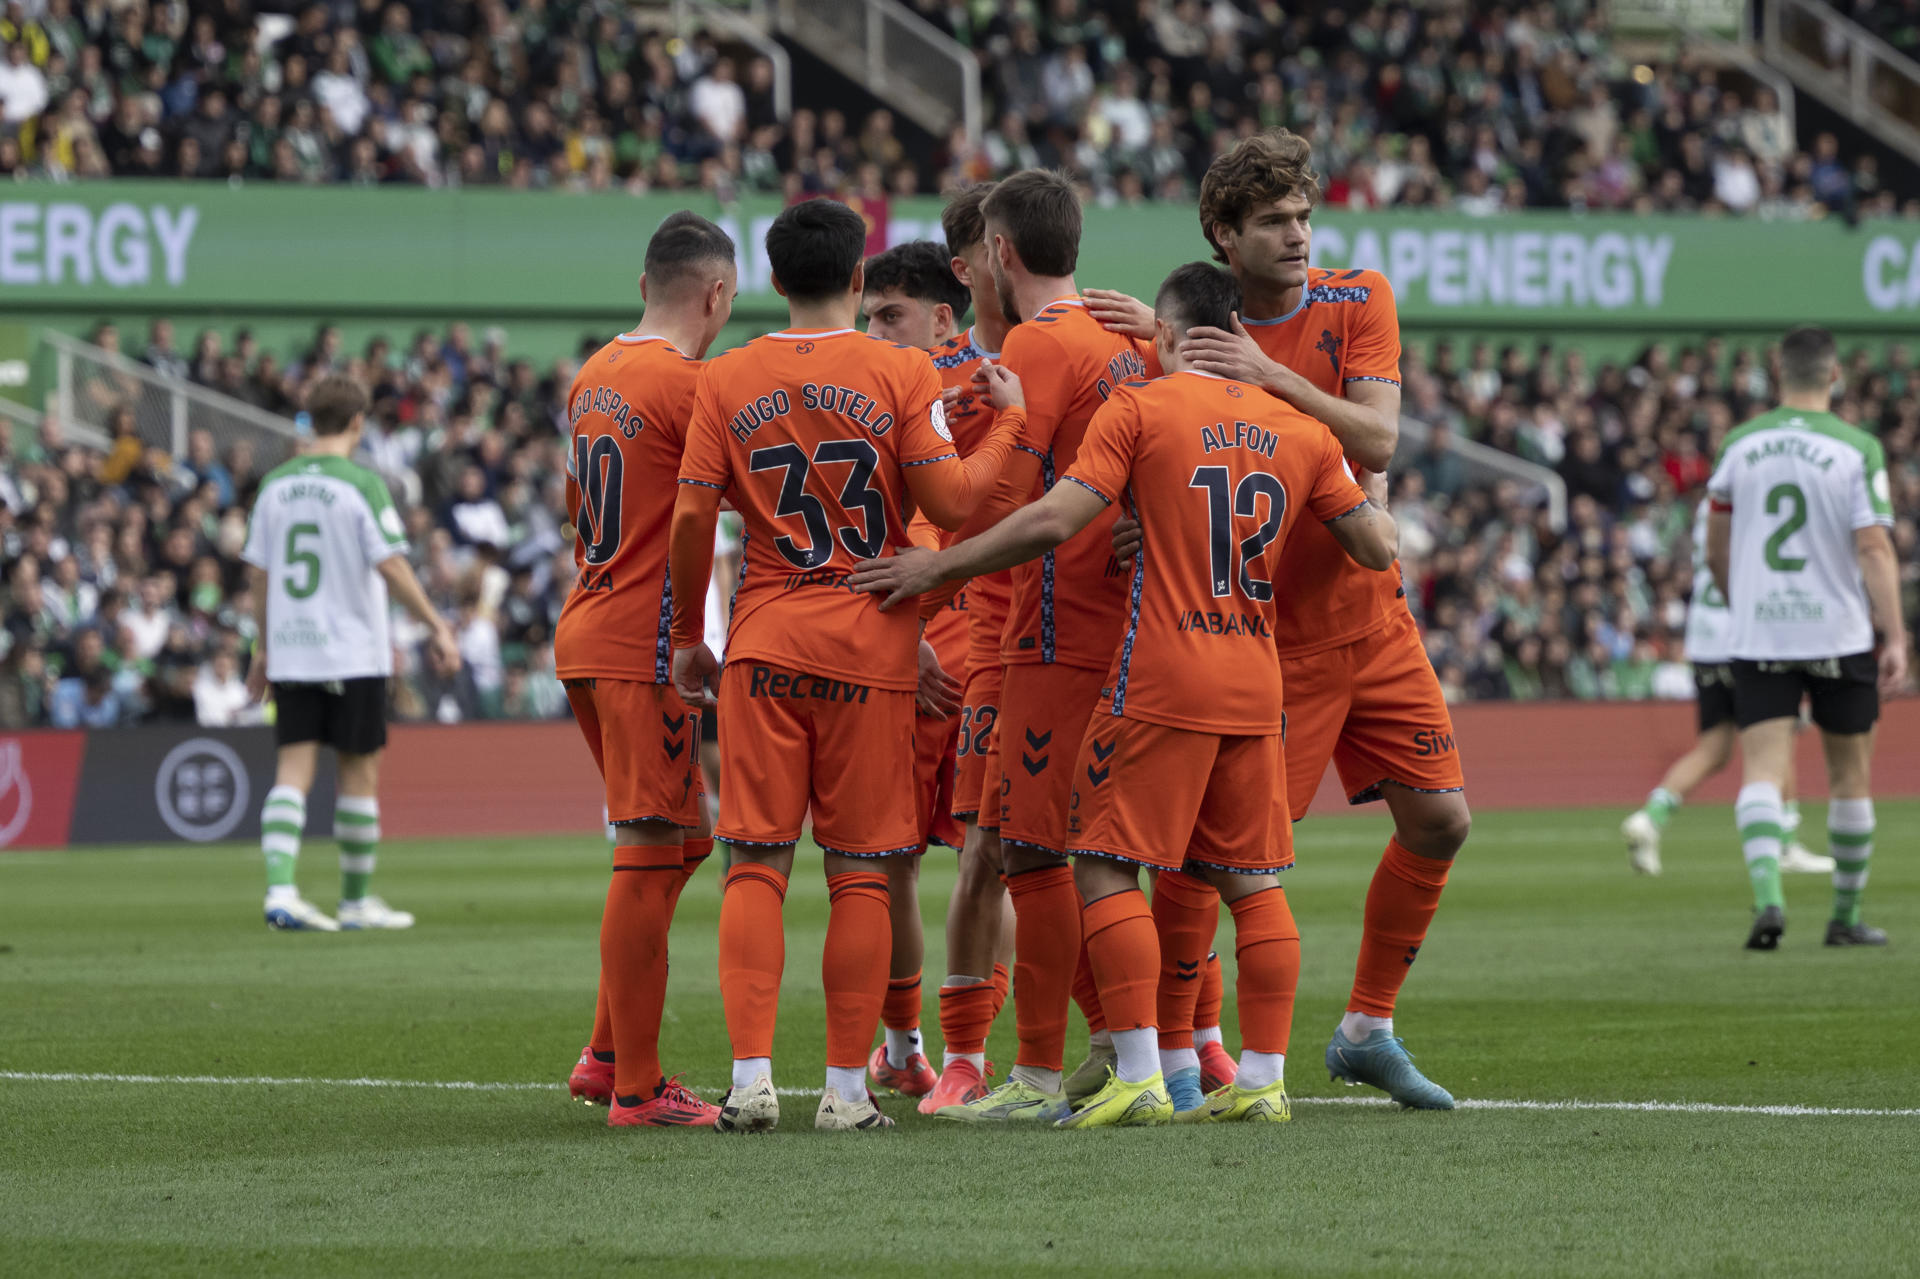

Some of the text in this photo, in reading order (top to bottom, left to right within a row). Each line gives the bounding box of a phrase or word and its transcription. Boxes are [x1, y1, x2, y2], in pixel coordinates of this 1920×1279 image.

[592, 385, 645, 439] ASPAS
[729, 388, 791, 444] HUGO
[801, 383, 895, 437] SOTELO
[1200, 420, 1279, 460] ALFON
[576, 434, 624, 566] 10
[749, 438, 888, 570] 33
[1188, 465, 1287, 603] 12
[1763, 482, 1808, 572] 2
[284, 522, 321, 600] 5
